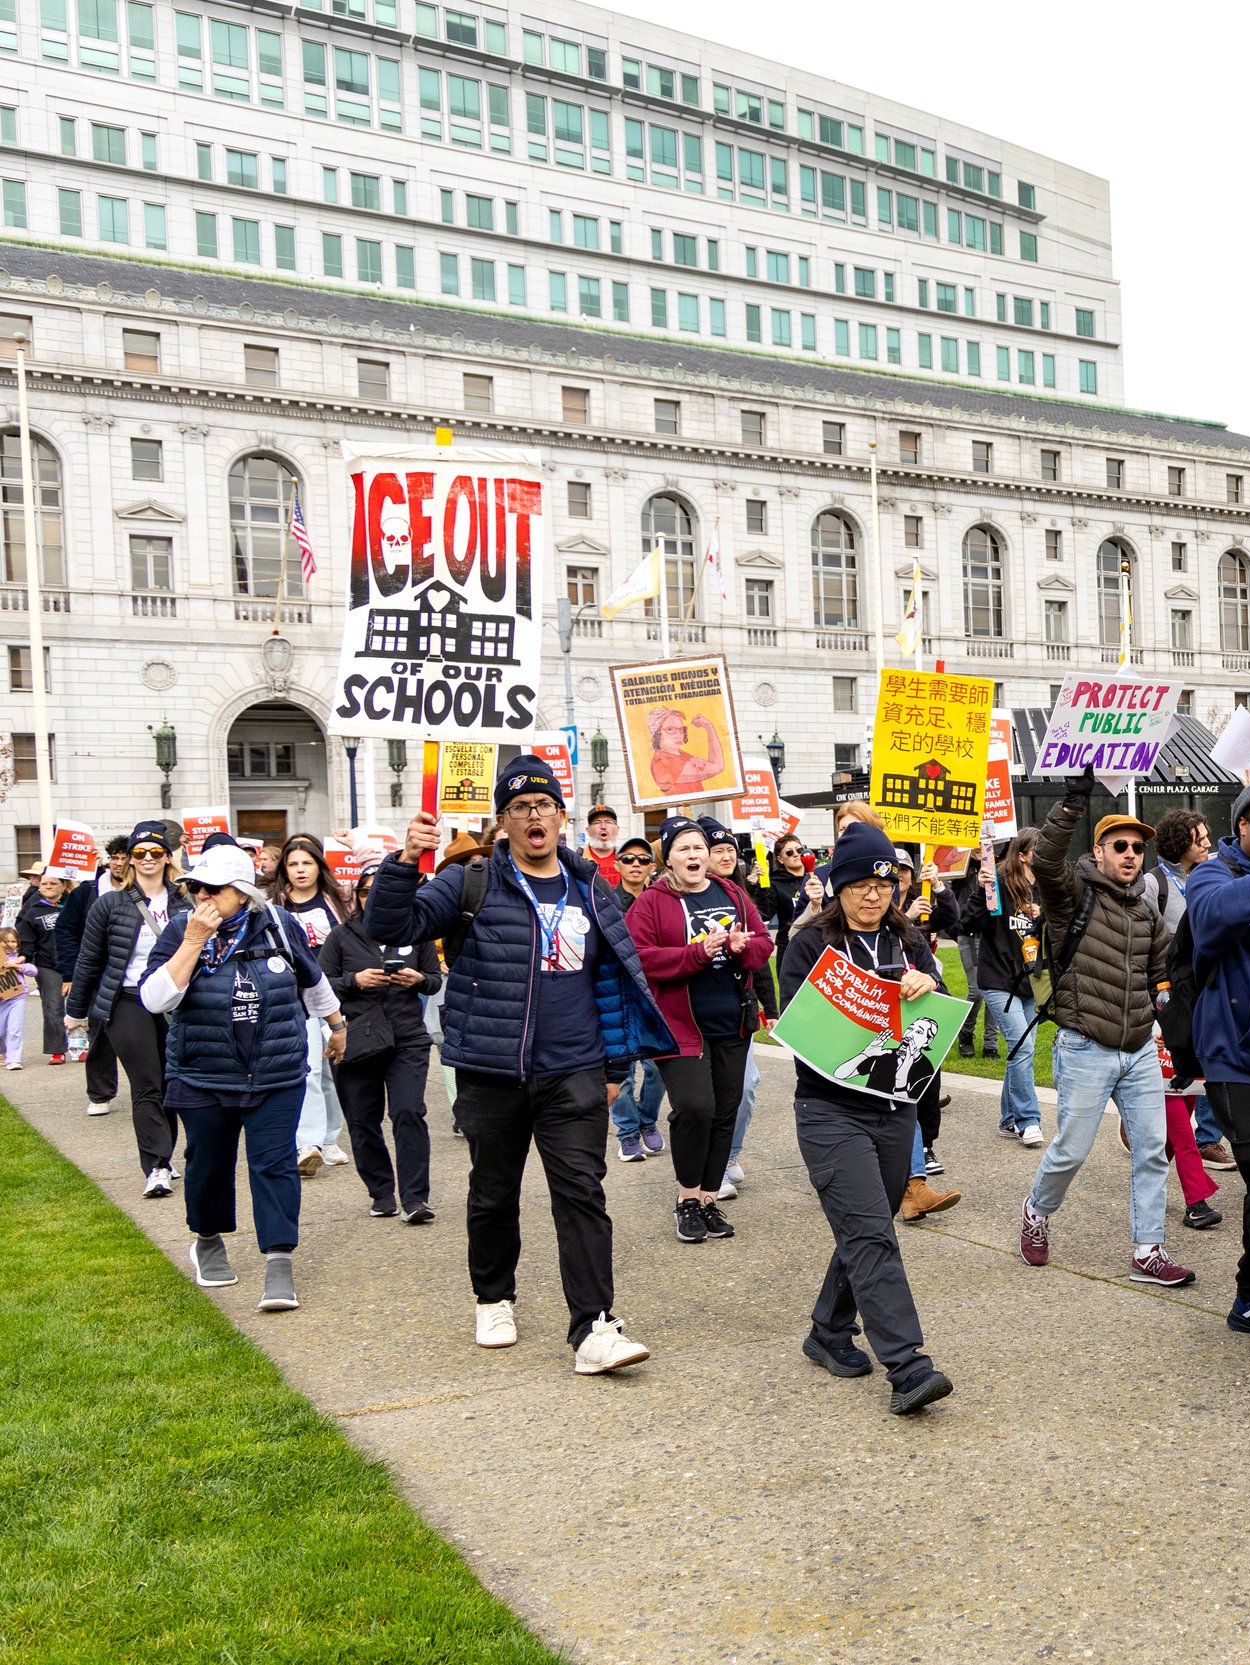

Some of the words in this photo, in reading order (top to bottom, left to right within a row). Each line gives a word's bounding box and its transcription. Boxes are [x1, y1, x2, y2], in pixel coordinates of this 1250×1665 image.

[349, 471, 437, 611] ICE
[443, 475, 544, 621] OUT
[391, 662, 423, 676] OF
[442, 664, 503, 682] OUR
[621, 673, 668, 687] SALARIOS
[670, 669, 709, 680] DIGNOS
[711, 668, 718, 676] Y
[624, 683, 675, 698] ATENCIÓN
[625, 694, 672, 706] TOTALMENTE
[675, 689, 721, 699] FINANCIADA
[886, 675, 989, 707] 學生需要師
[1071, 682, 1170, 711] PROTECT
[335, 674, 536, 730] SCHOOLS
[1079, 712, 1147, 734] PUBLIC
[480, 746, 493, 754] CON
[546, 747, 559, 755] ON
[890, 731, 974, 759] 定的學校
[449, 761, 484, 769] COMPLETO
[451, 753, 485, 761] PERSONAL
[1040, 742, 1160, 772] EDUCATION
[745, 774, 761, 783] ON
[848, 792, 864, 800] CENTER
[1191, 785, 1219, 793] GARAGE
[985, 799, 1011, 808] FAMILY
[192, 826, 221, 834] STRIKE
[878, 811, 979, 838] 我們不能等待
[72, 834, 85, 842] ON
[62, 842, 92, 853] STRIKE
[59, 858, 88, 866] STUDENTS
[814, 978, 833, 996] AND
[845, 987, 890, 1013] STUDENTS
